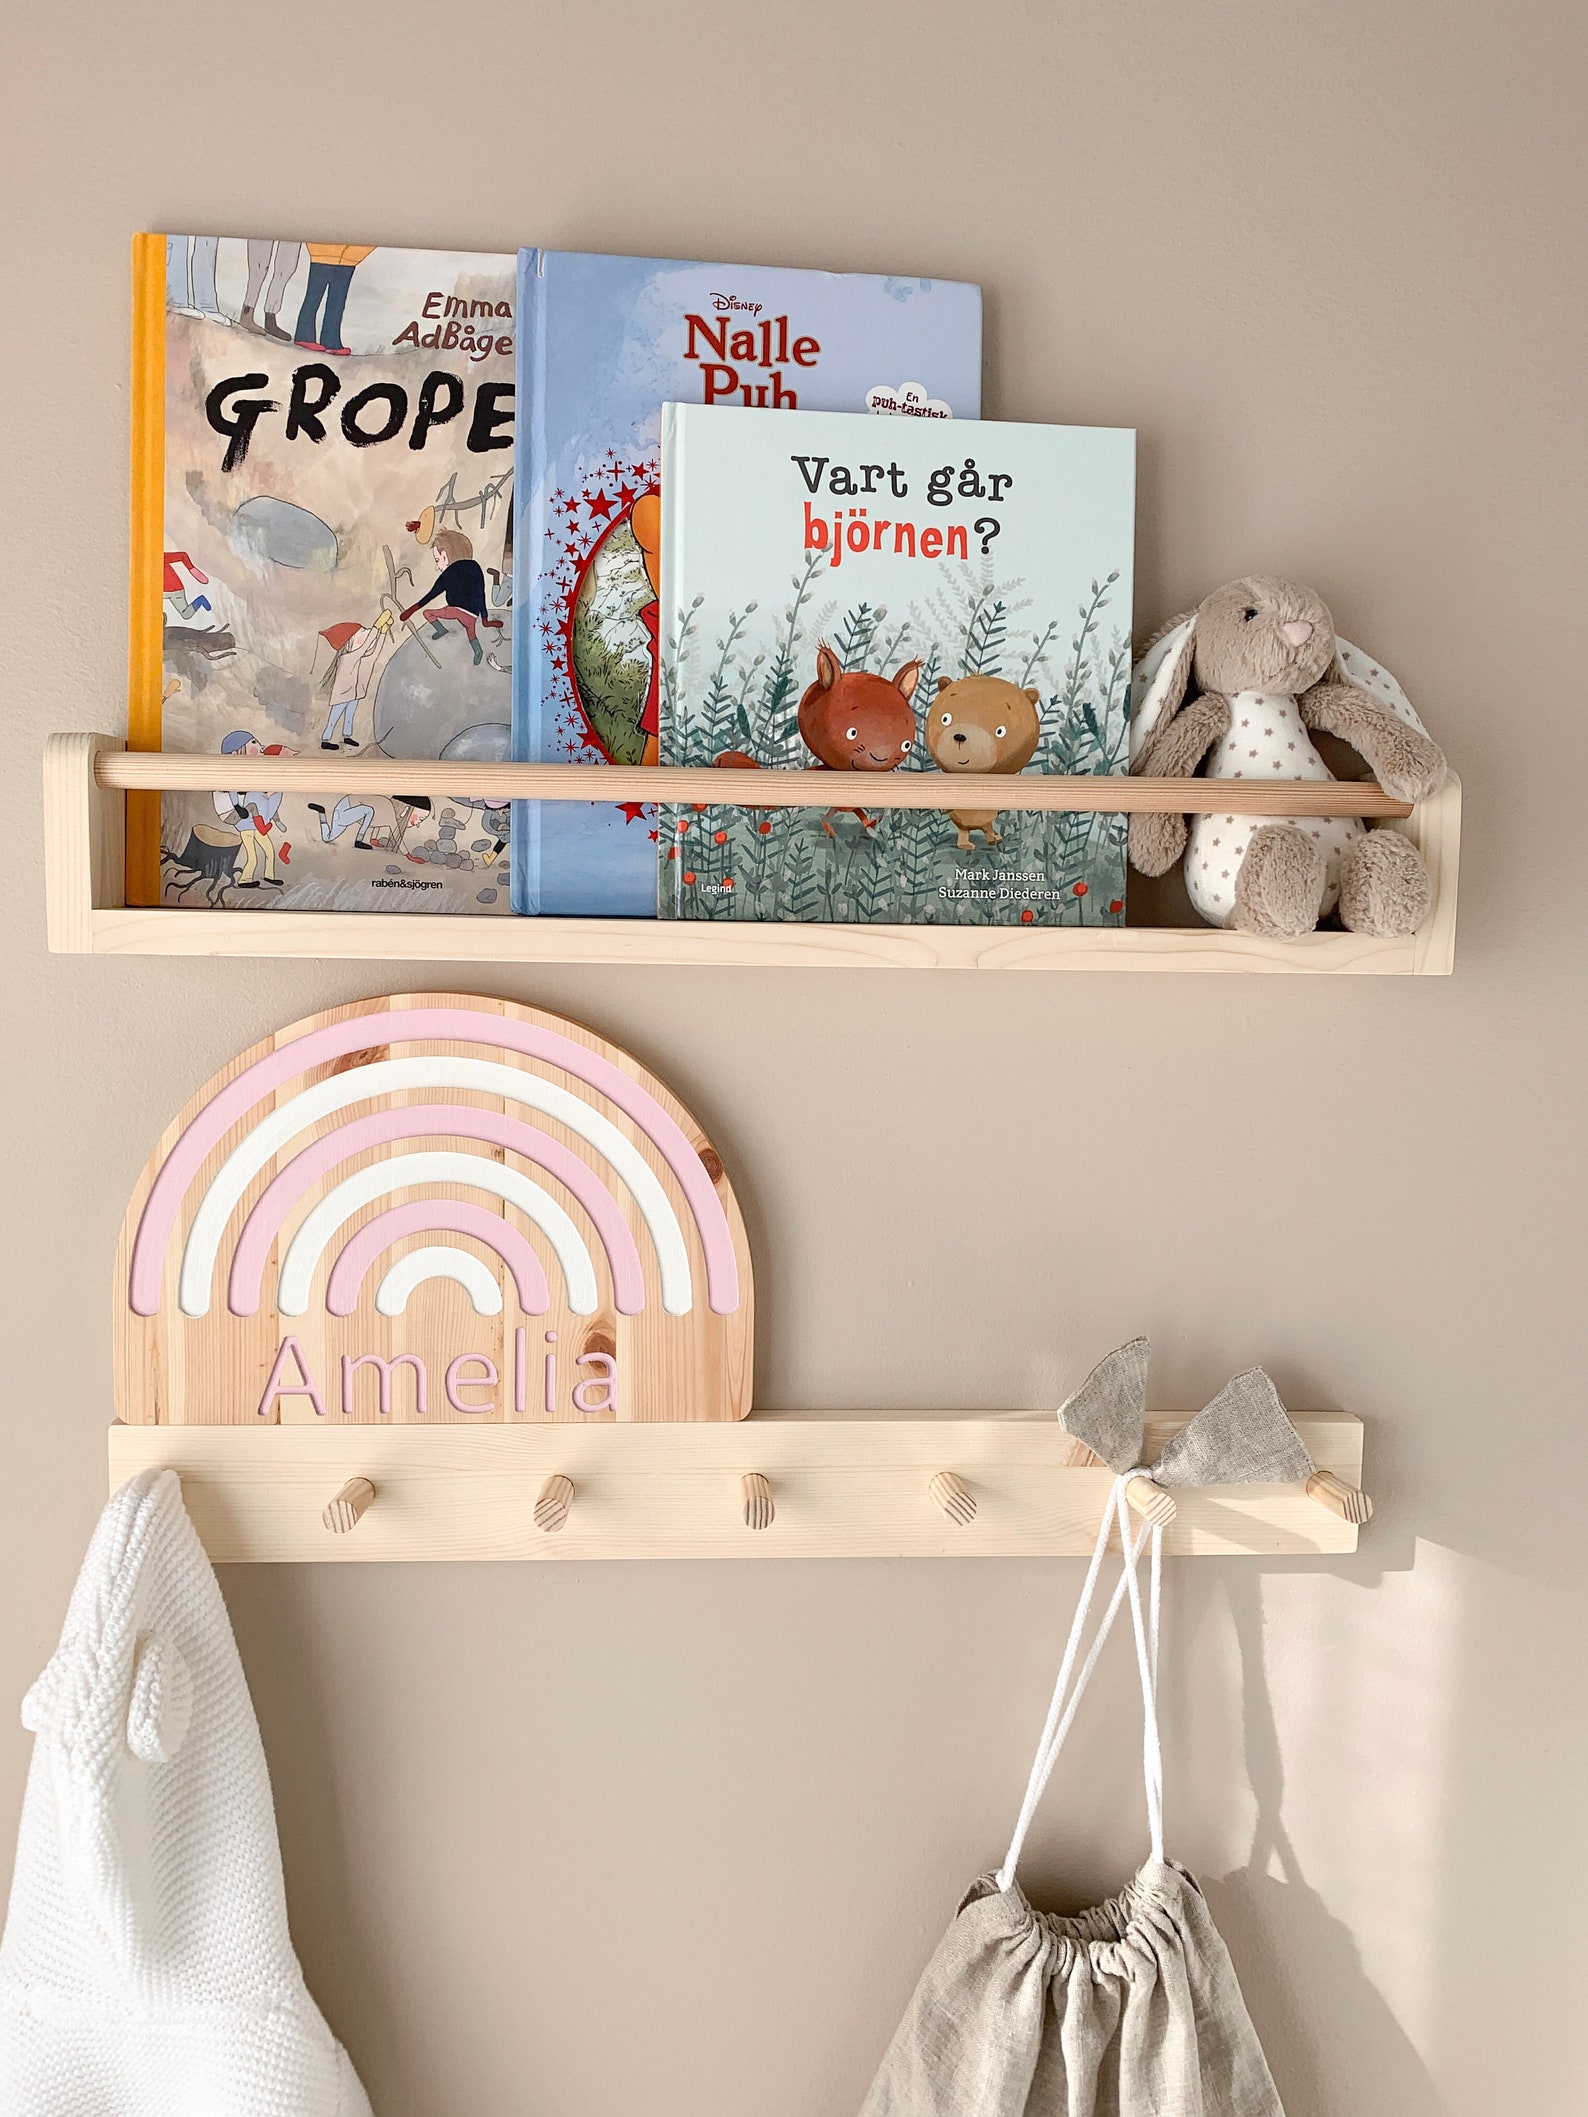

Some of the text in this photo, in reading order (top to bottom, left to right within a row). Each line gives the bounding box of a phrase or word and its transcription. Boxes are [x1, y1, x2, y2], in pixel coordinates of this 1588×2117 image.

[422, 292, 513, 319] Emma
[392, 321, 514, 362] AdBåge
[683, 314, 820, 367] Nalle
[699, 363, 798, 410] Puh
[906, 392, 919, 402] En
[791, 456, 1013, 505] Vart går
[803, 501, 1001, 567] björnen?
[371, 878, 443, 890] rabén&sjögren
[701, 883, 732, 895] Legind
[954, 867, 1045, 882] Mark Janssen
[938, 887, 1061, 901] Suzanne Diederen
[257, 1326, 618, 1416] Amelia
